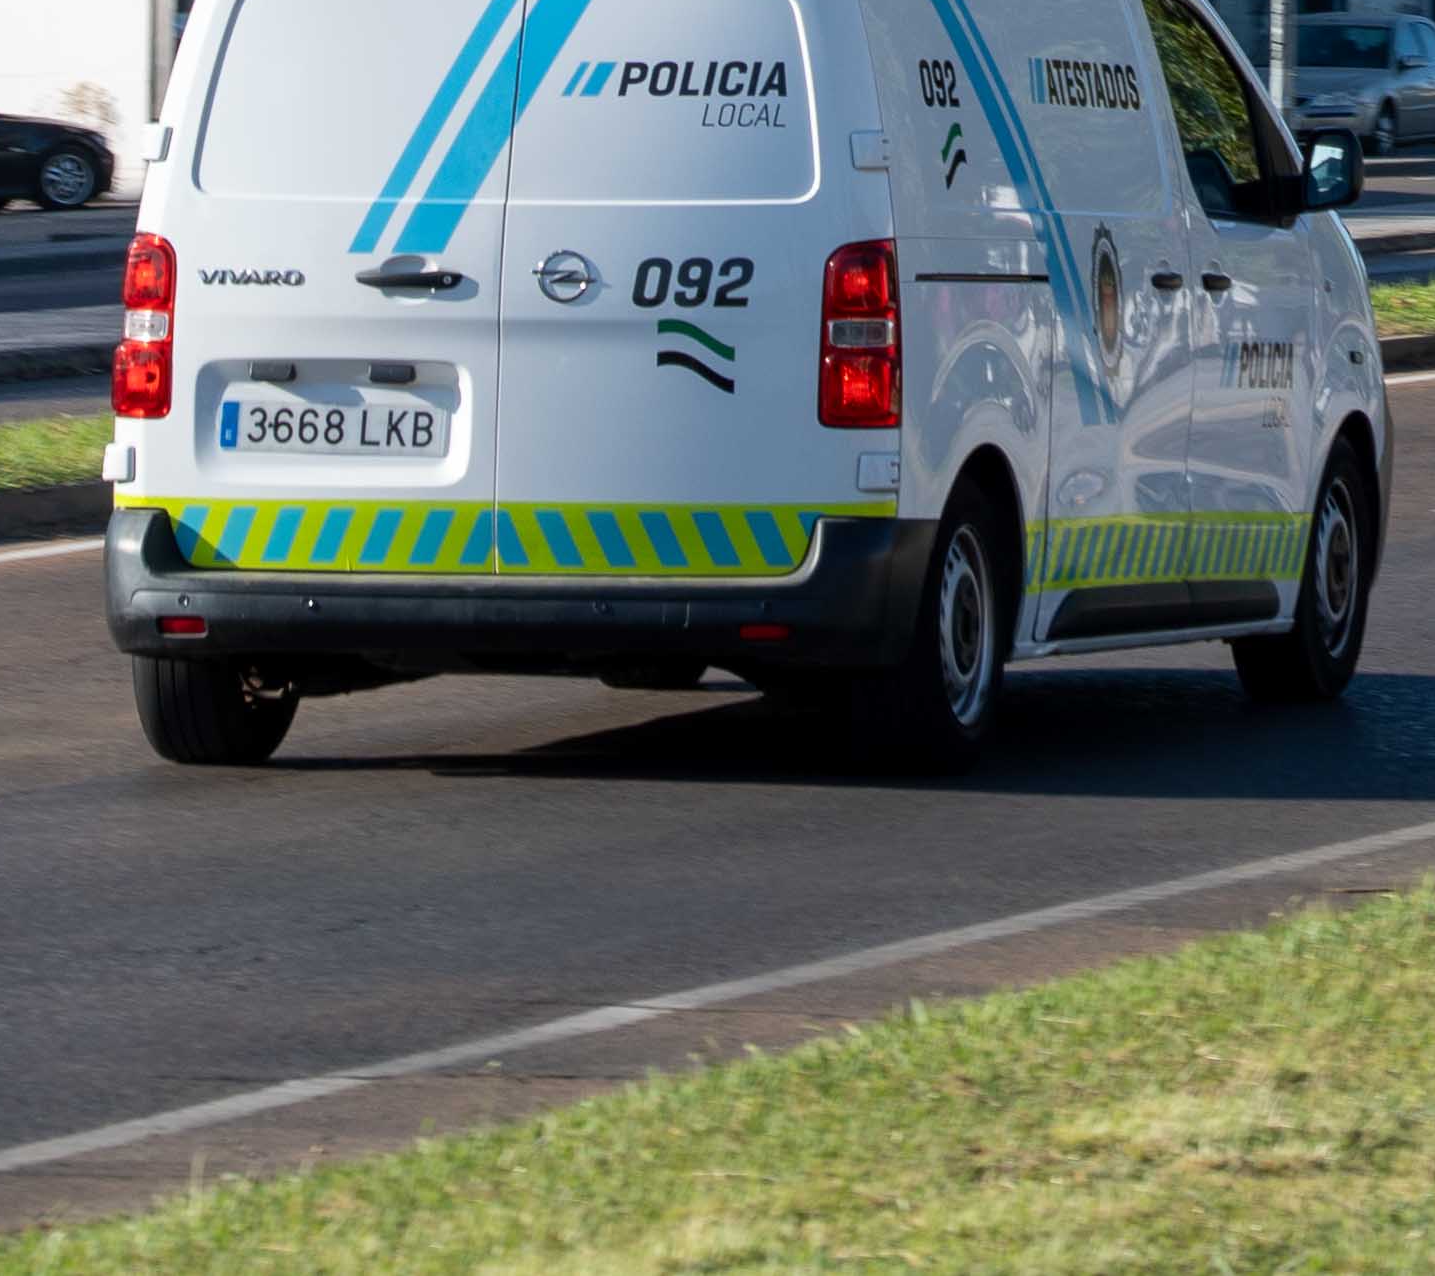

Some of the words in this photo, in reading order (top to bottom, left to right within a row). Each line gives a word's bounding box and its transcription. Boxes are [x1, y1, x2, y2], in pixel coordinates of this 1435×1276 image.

[618, 61, 788, 98] POLICIA
[919, 58, 961, 108] 092
[1045, 58, 1141, 111] ATESTADOS
[701, 103, 787, 128] LOCAL
[198, 269, 306, 287] VIVARO
[632, 257, 755, 309] 092
[1238, 341, 1294, 389] POLICIA
[247, 407, 345, 445] 3668
[360, 410, 435, 448] LKB
